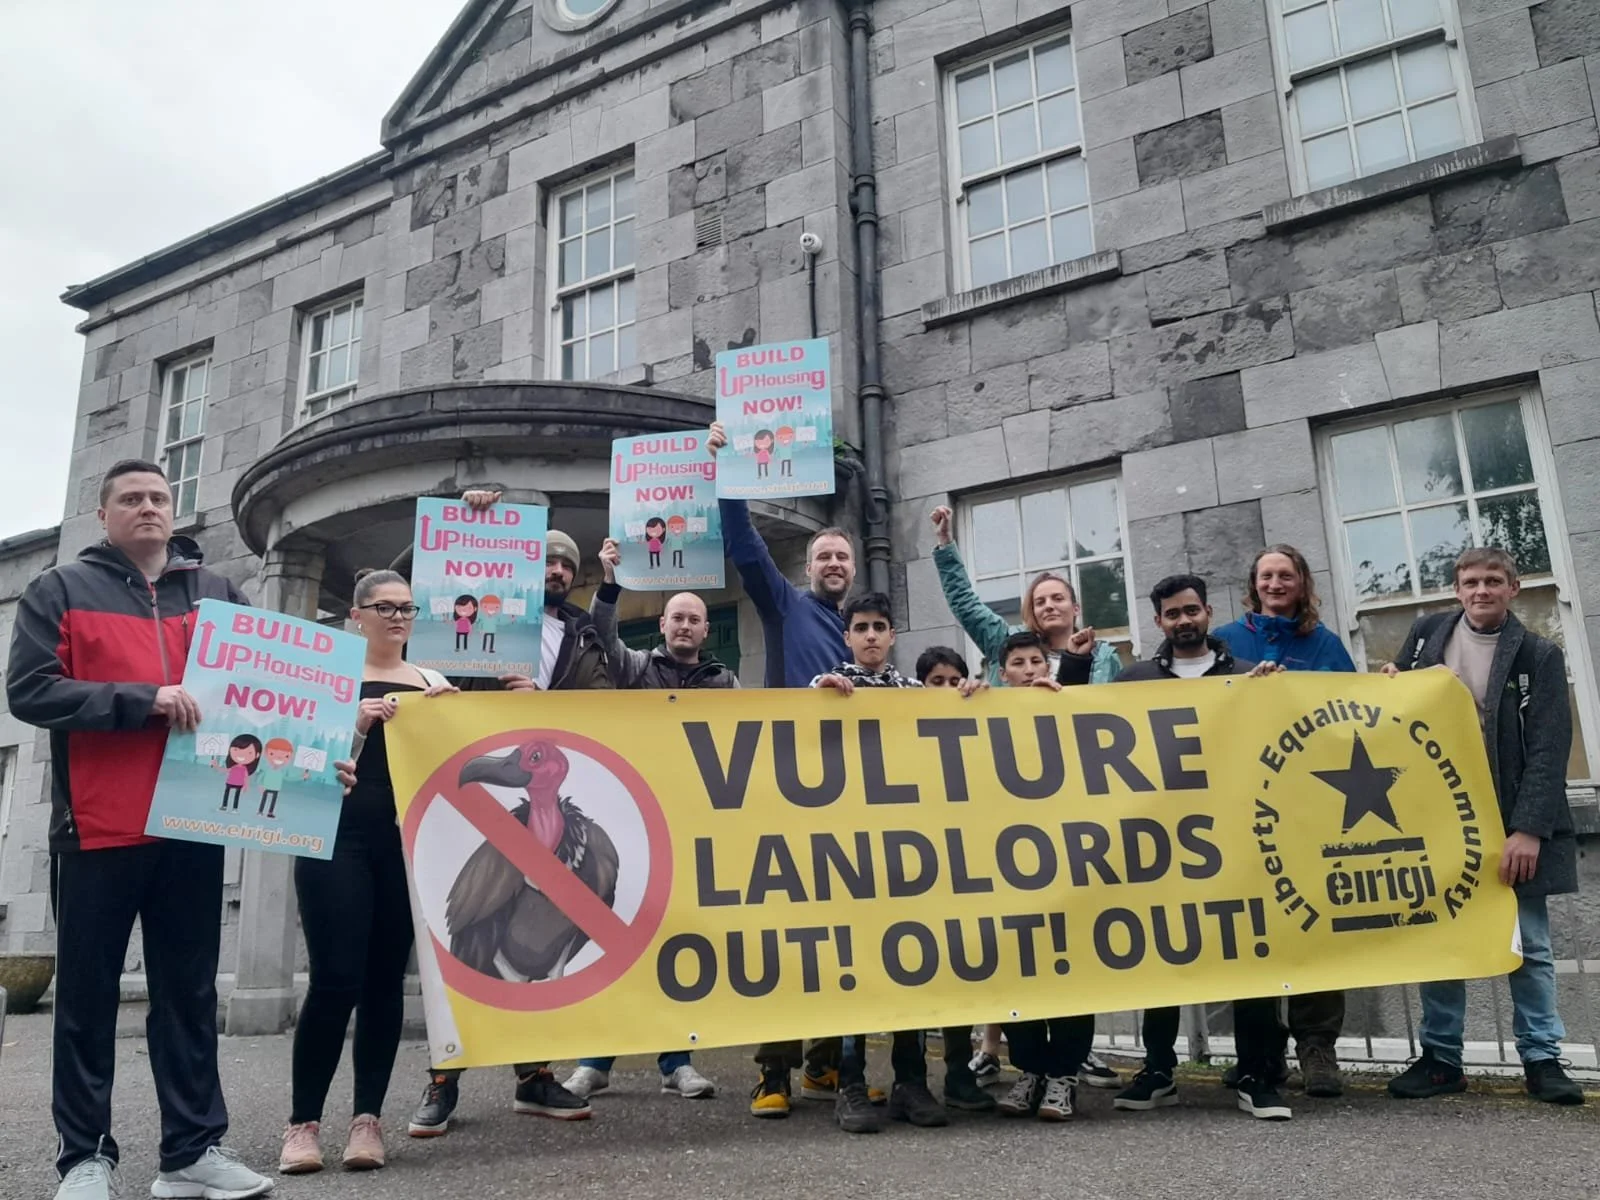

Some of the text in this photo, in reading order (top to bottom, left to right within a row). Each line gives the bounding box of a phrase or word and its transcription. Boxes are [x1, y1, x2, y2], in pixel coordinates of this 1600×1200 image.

[737, 346, 804, 368] BUILD
[720, 367, 825, 397] UP Housing
[743, 395, 803, 416] NOW!
[632, 437, 698, 456] BUILD
[615, 454, 716, 484] UP Housing
[636, 485, 694, 502] NOW!
[442, 505, 521, 525] BUILD
[419, 514, 541, 561] UP Housing
[445, 559, 514, 578] NOW!
[231, 612, 334, 653] BUILD
[196, 620, 355, 703] UP Housing
[224, 683, 317, 721] NOW!
[1259, 699, 1382, 774] Equality
[682, 707, 1209, 810] VULTURE
[162, 815, 323, 852] www.eirigi.org
[1409, 720, 1482, 919] Community
[694, 814, 1222, 907] LANDLORDS
[1252, 798, 1320, 933] Liberty
[656, 898, 1270, 1003] OUT! OUT! OUT!
